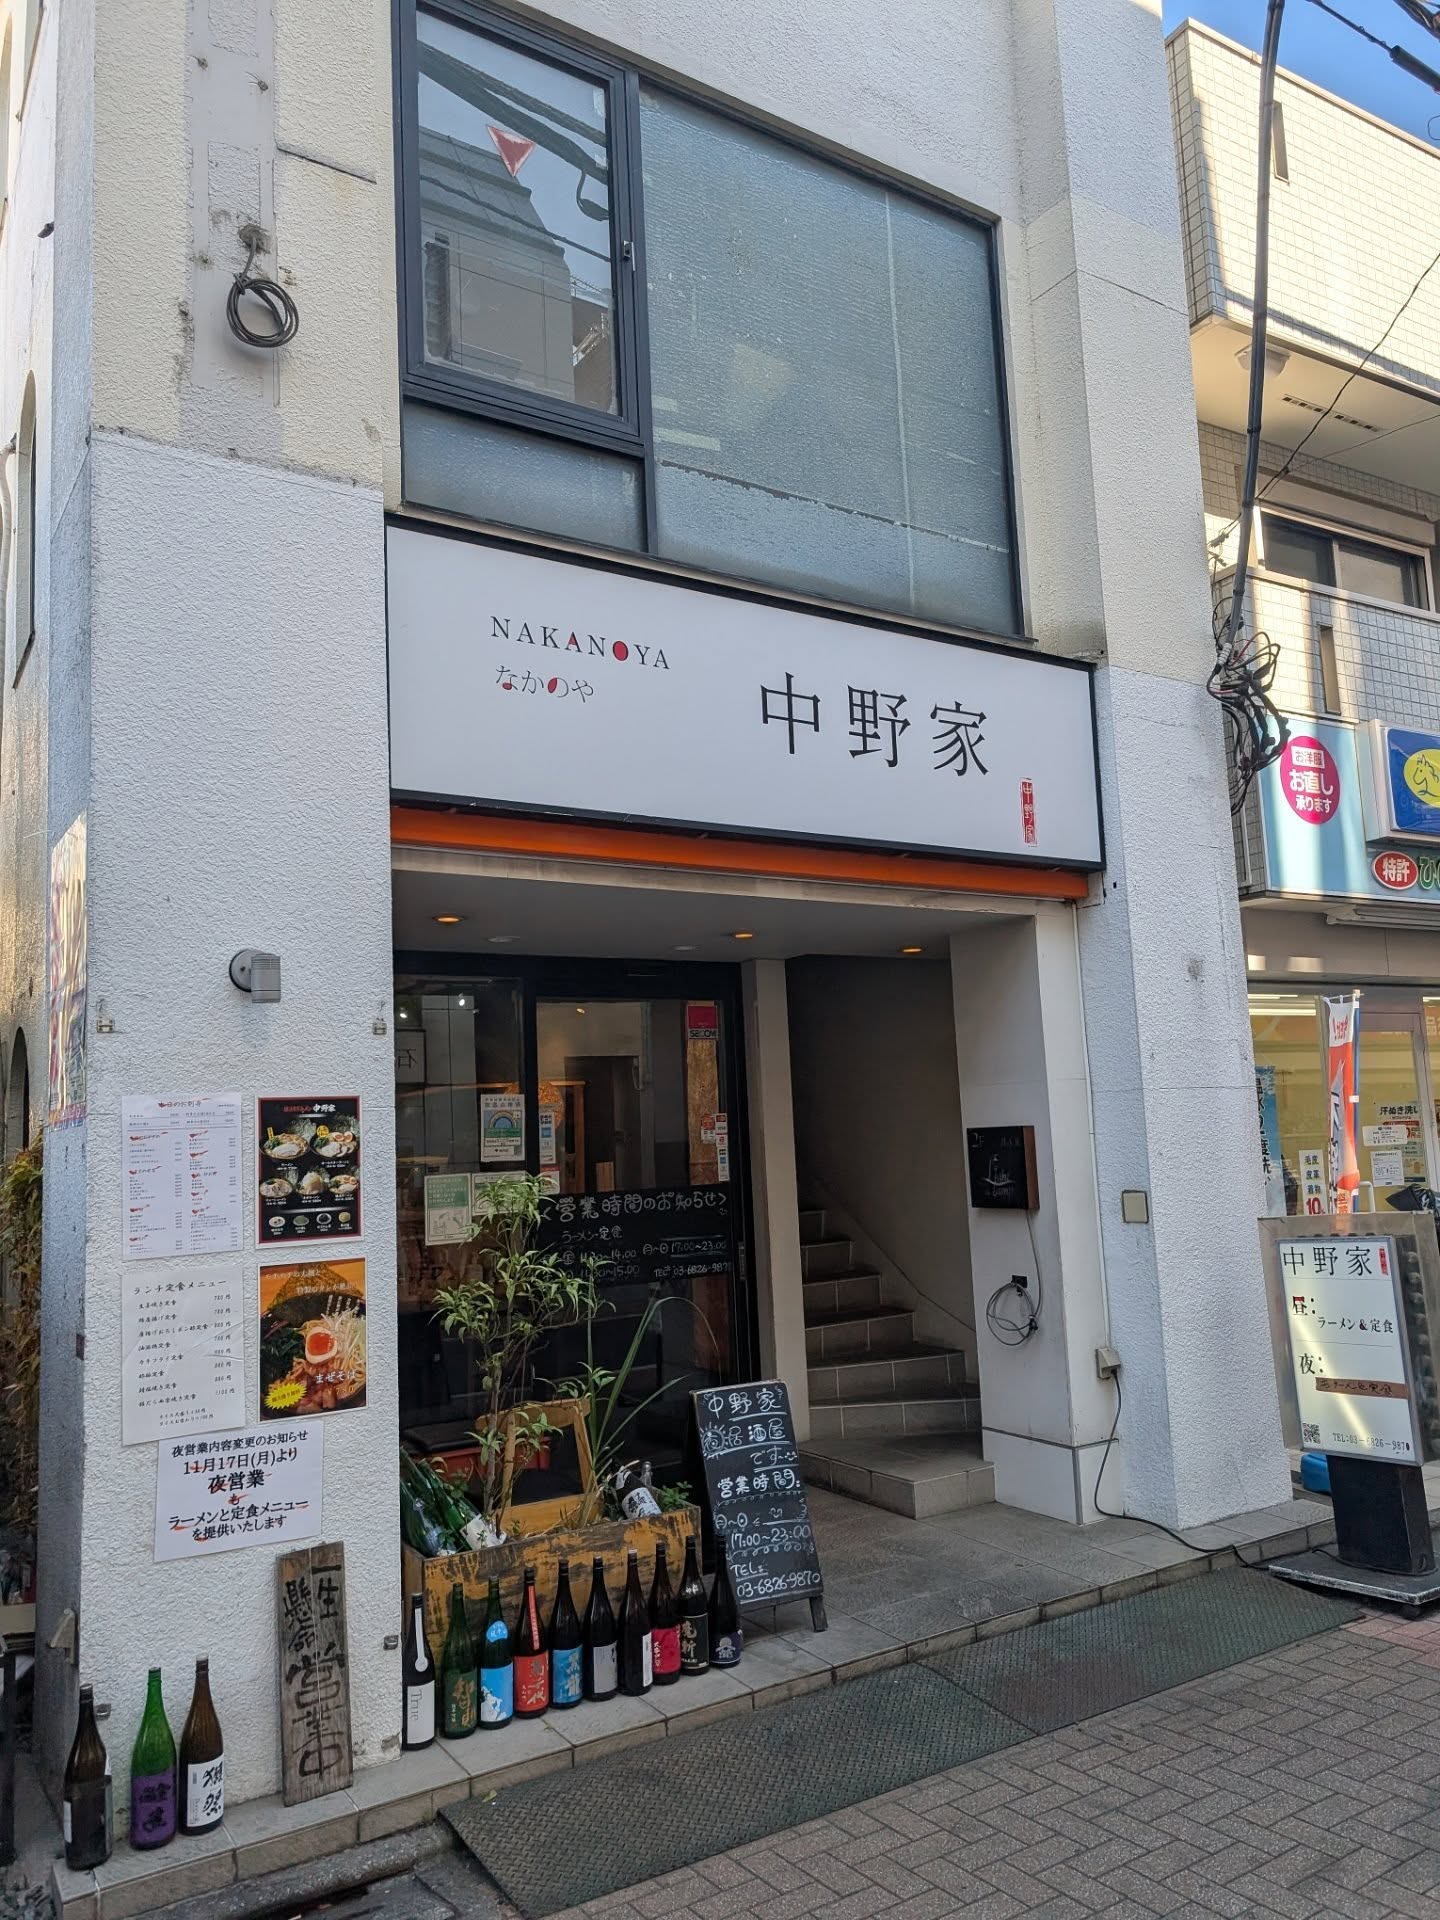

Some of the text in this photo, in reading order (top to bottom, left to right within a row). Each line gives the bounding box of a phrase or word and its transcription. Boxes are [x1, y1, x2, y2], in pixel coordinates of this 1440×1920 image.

[490, 616, 670, 670] NAKANOYA
[495, 665, 594, 703] なかのや
[760, 672, 989, 776] 中野家
[1295, 750, 1323, 766] お洋服
[1289, 768, 1334, 796] お直し
[1295, 794, 1332, 814] 承ります
[1382, 857, 1411, 883] 特許
[1419, 856, 1440, 890] ひ
[1283, 1246, 1373, 1276] 中野家
[134, 1280, 227, 1295] ランチ定食メニュー
[1292, 1296, 1316, 1315] 昼:
[1318, 1316, 1394, 1334] ラーメン&定食
[315, 1370, 356, 1383] まぜそば
[1299, 1353, 1323, 1374] 夜:
[708, 1387, 782, 1419] 中野家
[172, 1430, 308, 1458] 夜営業内容変更のお知らせ
[184, 1447, 298, 1475] 11月17日(月)より
[208, 1468, 265, 1494] 夜営業
[228, 1493, 241, 1506] も
[169, 1501, 309, 1530] ラーメンと定食メニュー
[192, 1514, 287, 1541] を提供いたします
[731, 1525, 811, 1550] 17:00~23:00
[311, 1564, 342, 1619] 一生
[736, 1571, 821, 1597] 03-6826-9870
[284, 1576, 318, 1651] 懸命
[286, 1642, 346, 1781] 営業中
